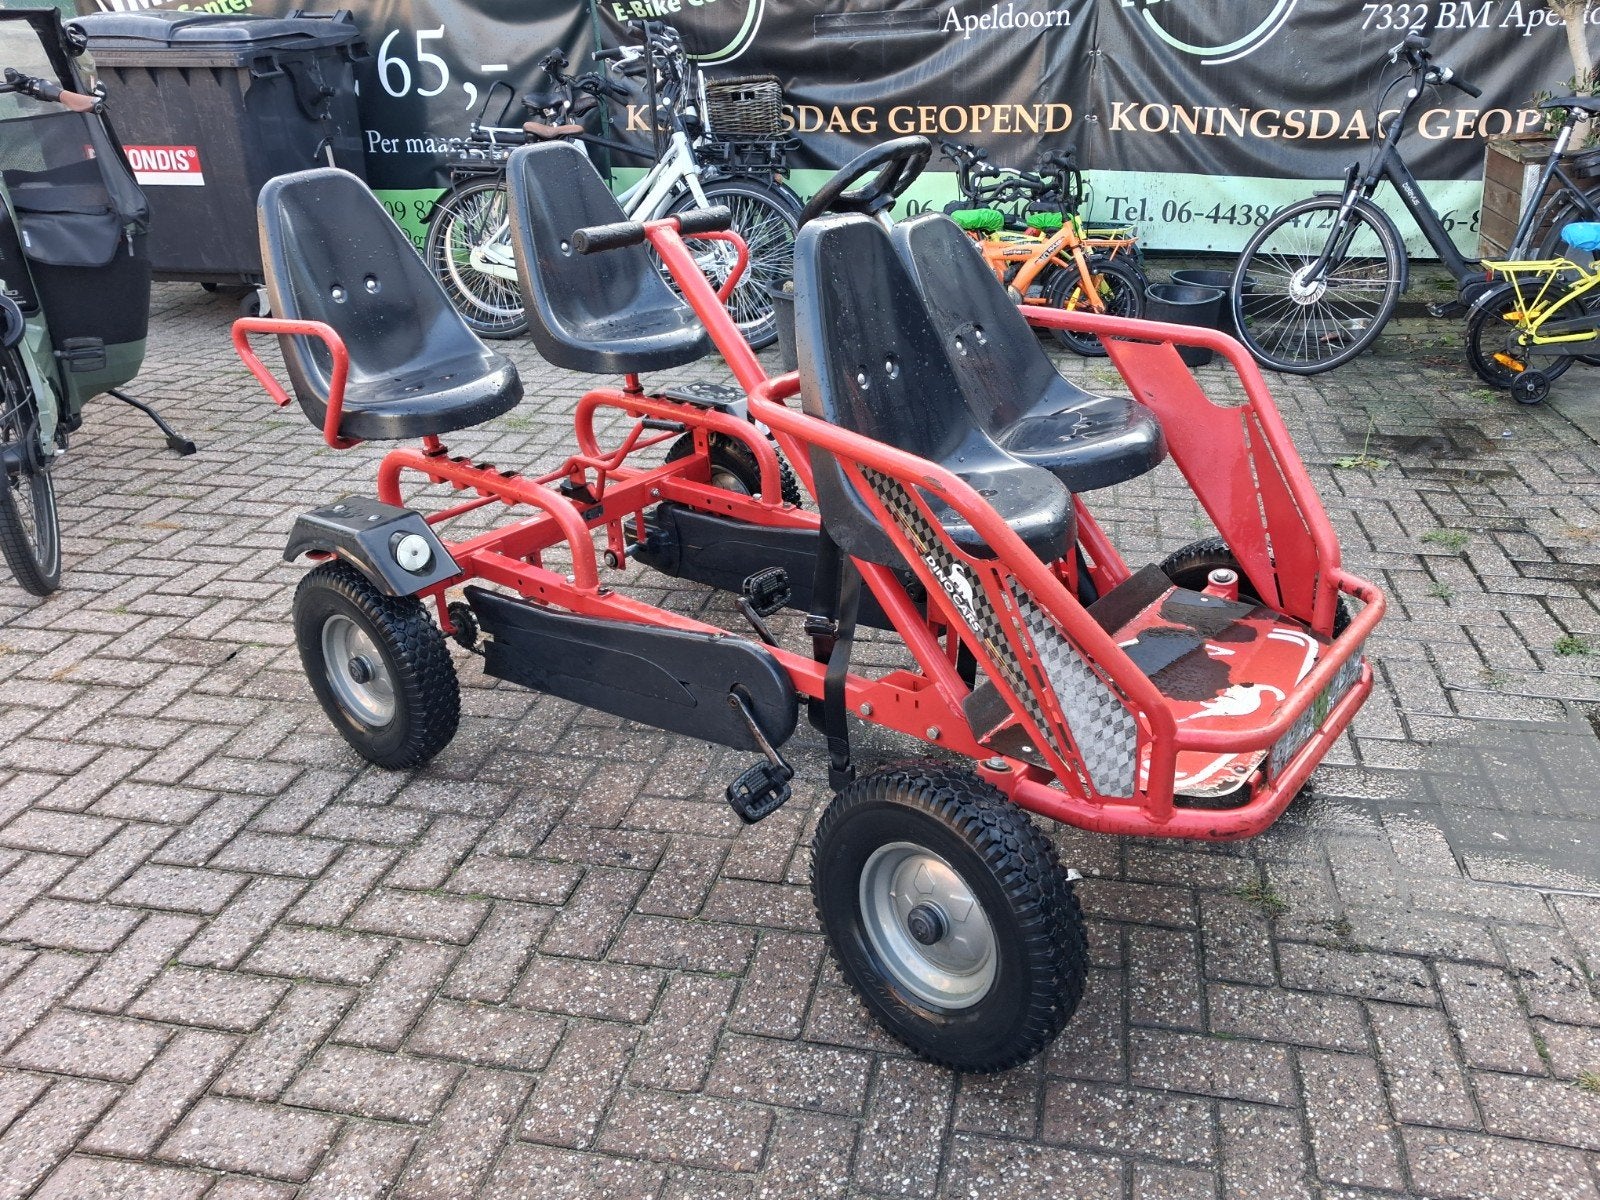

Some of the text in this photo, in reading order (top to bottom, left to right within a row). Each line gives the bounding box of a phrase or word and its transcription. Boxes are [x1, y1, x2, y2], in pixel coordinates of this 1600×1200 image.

[612, 0, 682, 21] E-Bike
[941, 3, 1071, 39] Apeldoorn
[1361, 3, 1428, 30] 7332
[1435, 1, 1494, 30] BM
[888, 103, 1073, 134] GEOPEND
[365, 130, 399, 154] Per
[1105, 196, 1153, 222] Tel.
[926, 555, 981, 632] DINO CARS
